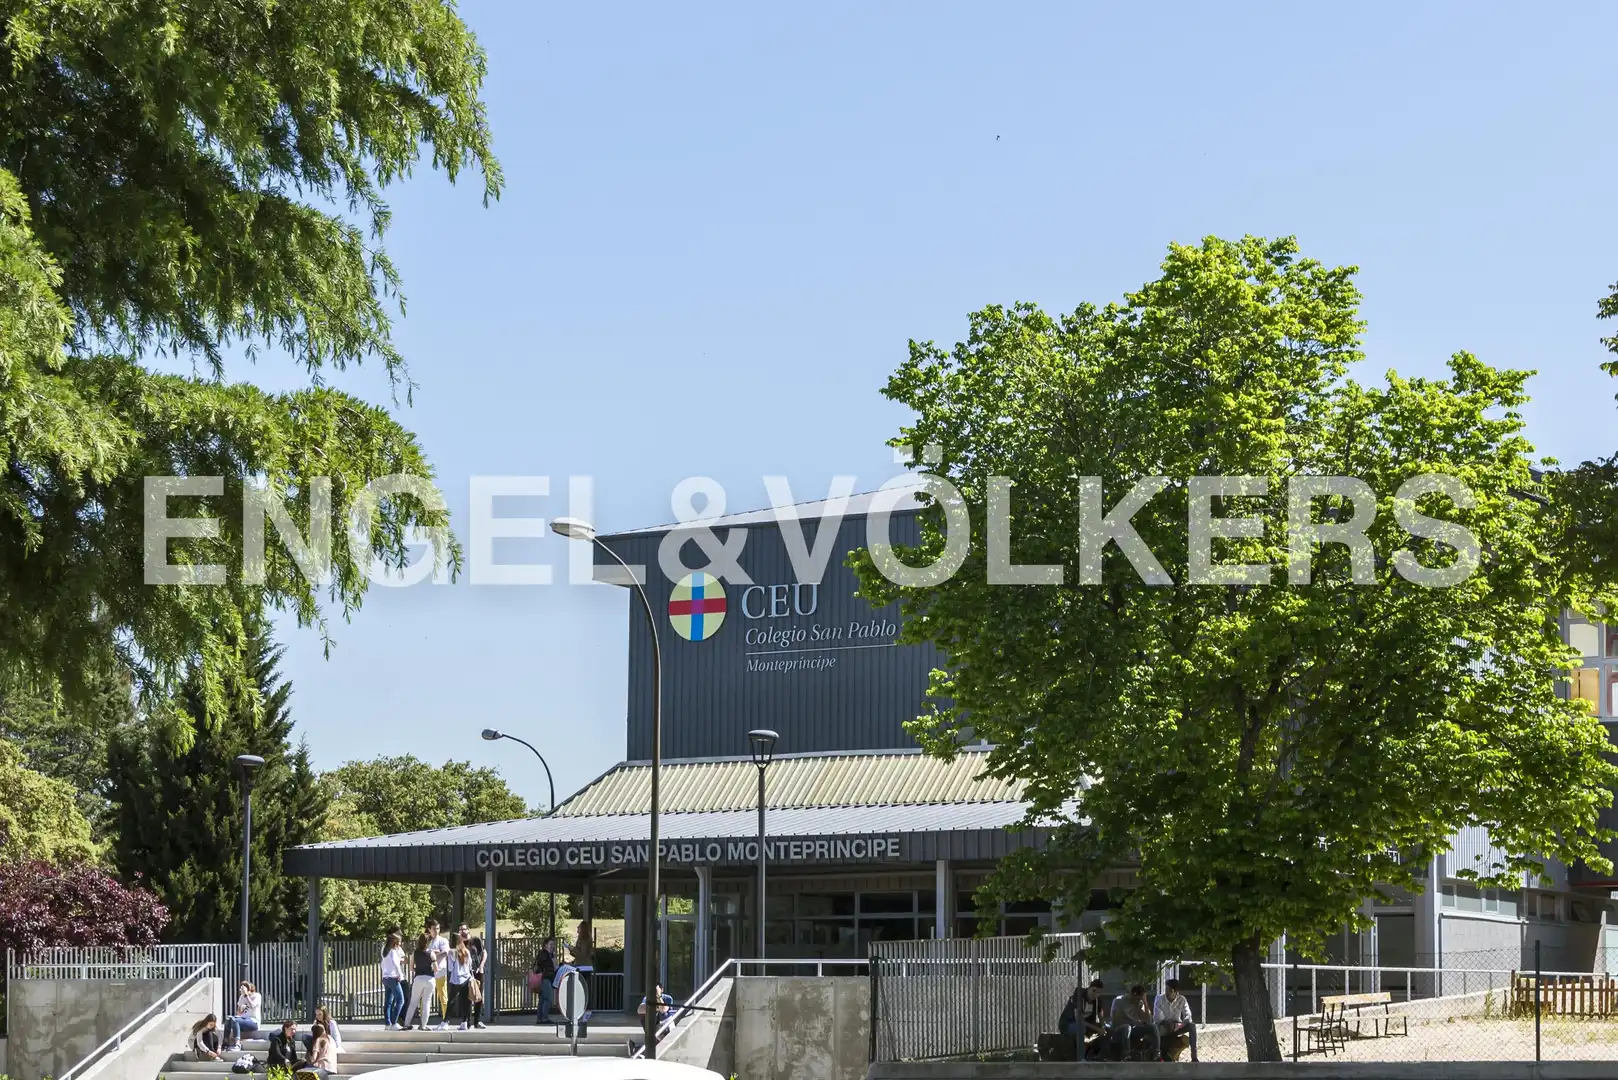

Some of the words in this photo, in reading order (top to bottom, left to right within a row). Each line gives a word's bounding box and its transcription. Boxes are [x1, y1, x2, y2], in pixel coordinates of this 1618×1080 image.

[741, 583, 819, 619] CEU
[745, 625, 806, 648] Colegio
[810, 623, 843, 641] San
[848, 619, 897, 639] Pablo
[476, 847, 560, 867] COLEGIO
[565, 846, 604, 865] CEU
[610, 844, 649, 863] SAN
[657, 842, 721, 862] PABLO
[727, 838, 900, 860] MONTEPRINCIPE
